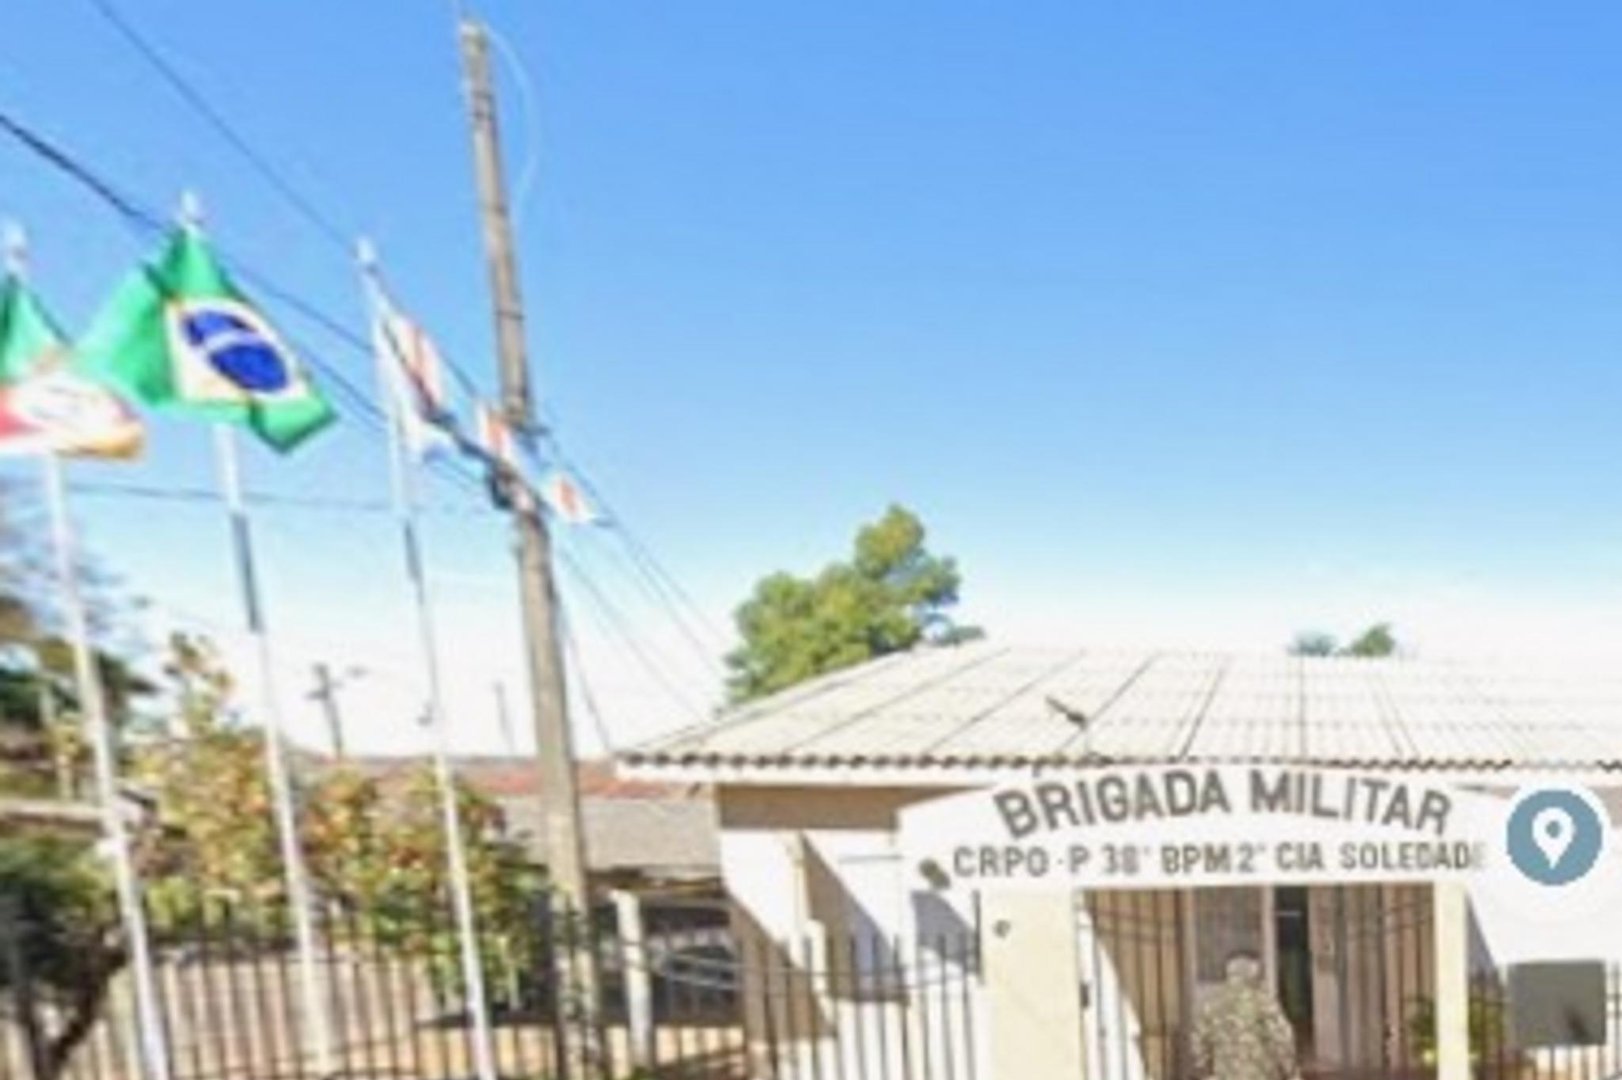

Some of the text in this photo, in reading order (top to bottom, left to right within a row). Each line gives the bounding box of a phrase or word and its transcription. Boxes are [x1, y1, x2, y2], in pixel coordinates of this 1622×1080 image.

[993, 769, 1452, 838] BRIGADA MILITAR
[1276, 842, 1324, 869] CIA
